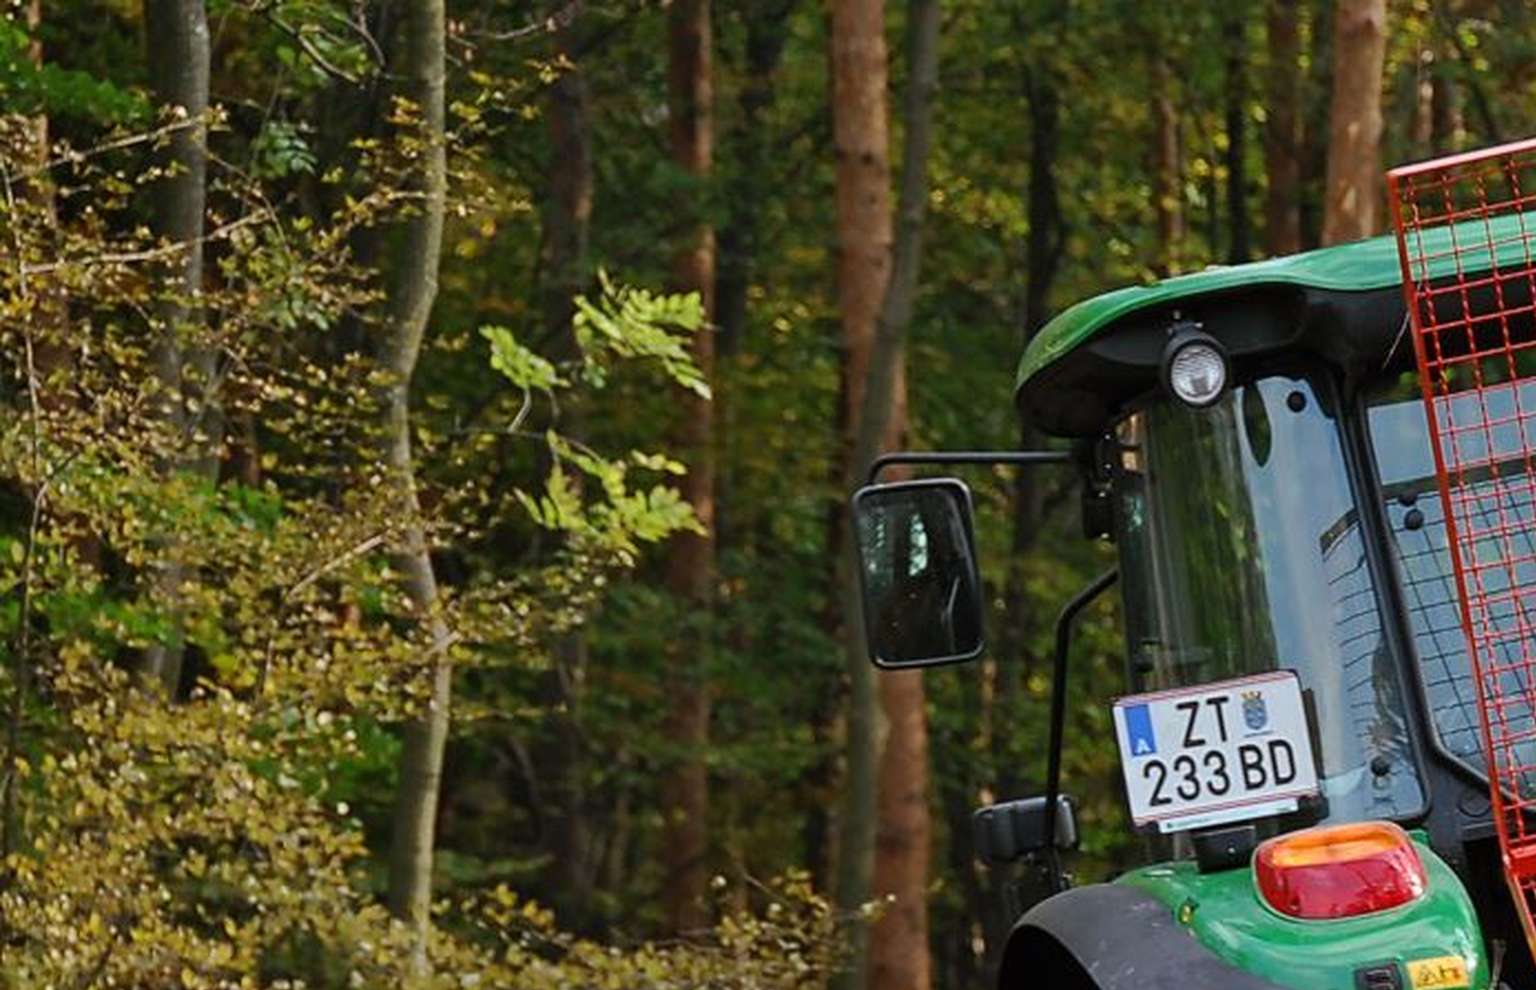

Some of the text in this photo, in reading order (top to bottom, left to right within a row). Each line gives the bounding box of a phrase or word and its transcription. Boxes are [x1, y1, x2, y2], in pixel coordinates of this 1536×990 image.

[1135, 738, 1152, 755] A
[1175, 696, 1230, 749] ZT
[1142, 739, 1297, 807] 233 BD
